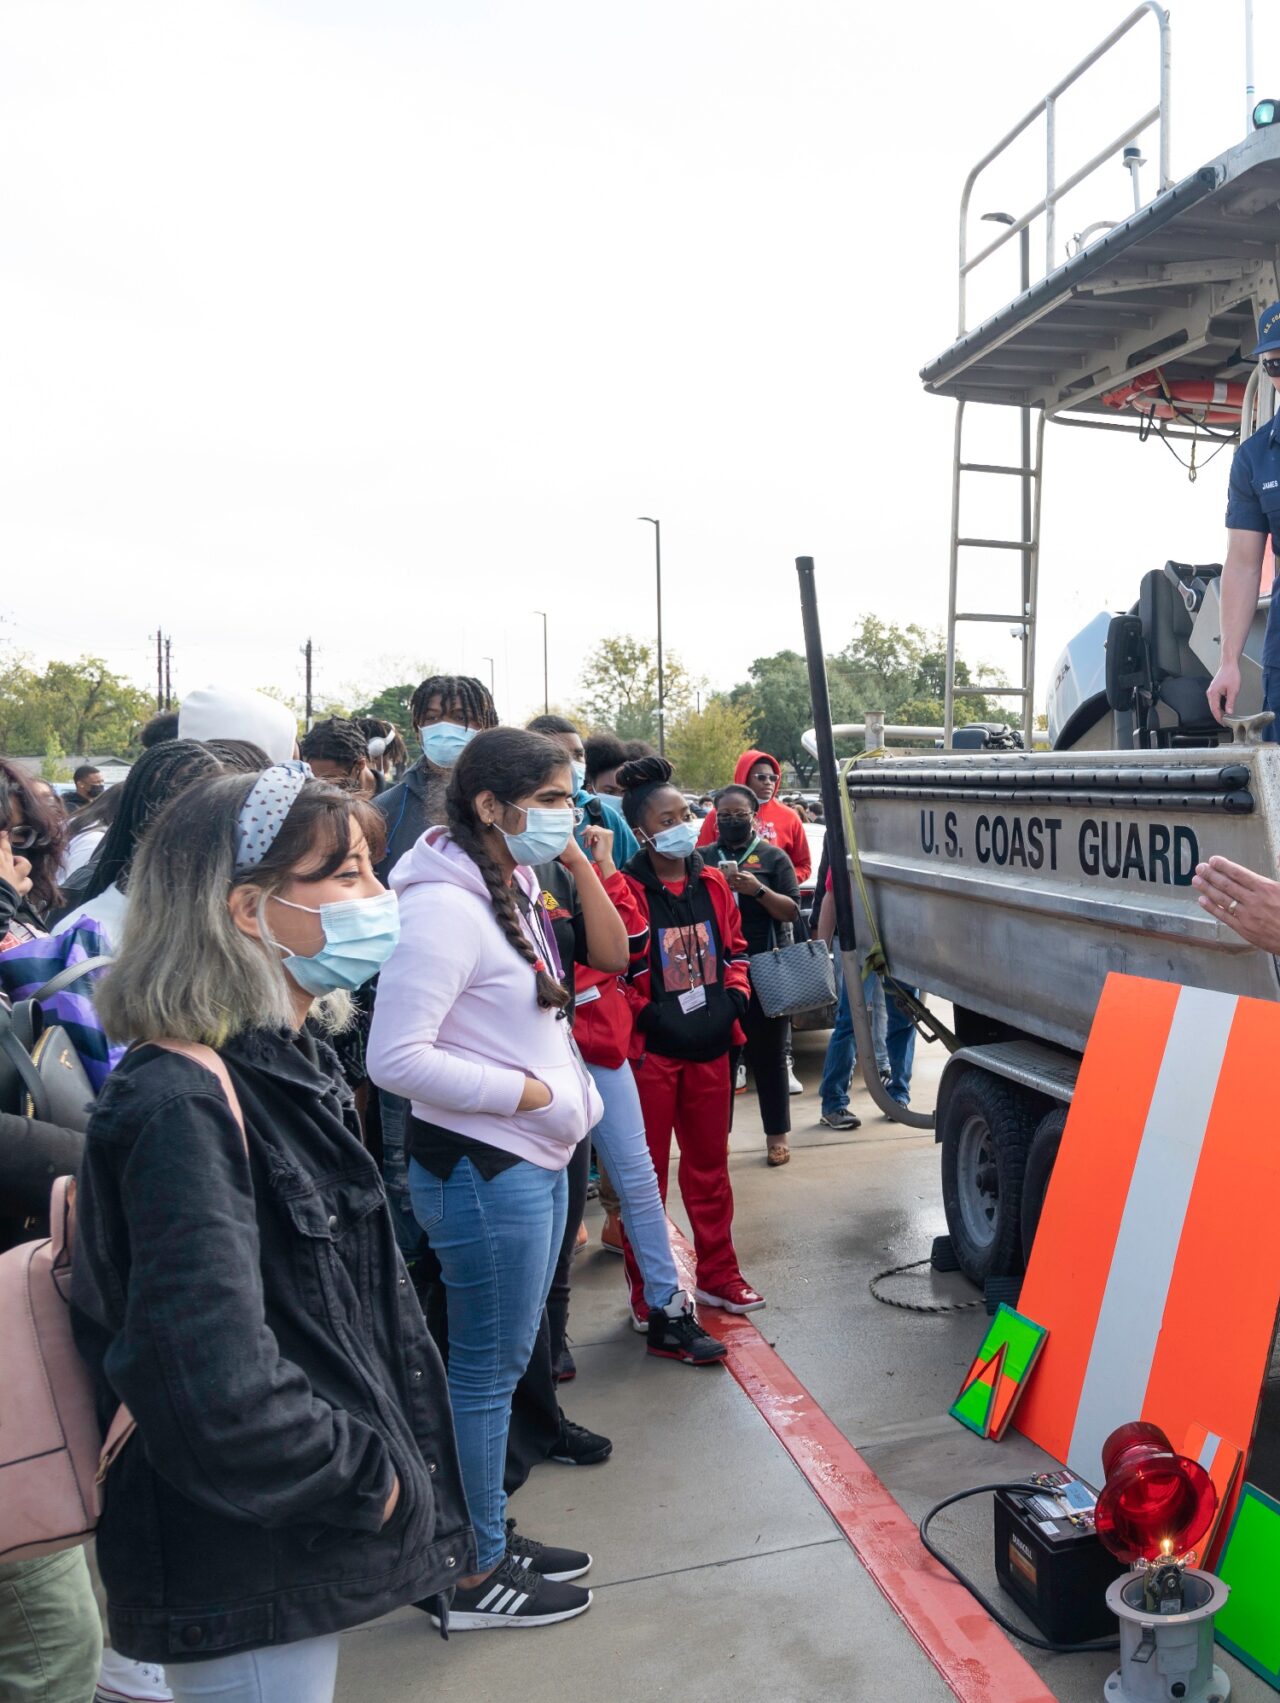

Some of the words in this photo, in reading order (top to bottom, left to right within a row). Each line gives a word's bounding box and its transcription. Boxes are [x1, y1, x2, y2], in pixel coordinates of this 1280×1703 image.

[1262, 480, 1279, 490] JAMES
[975, 815, 1062, 871] COAST
[1078, 819, 1200, 887] GUARD
[1012, 1533, 1033, 1560] DURACELL
